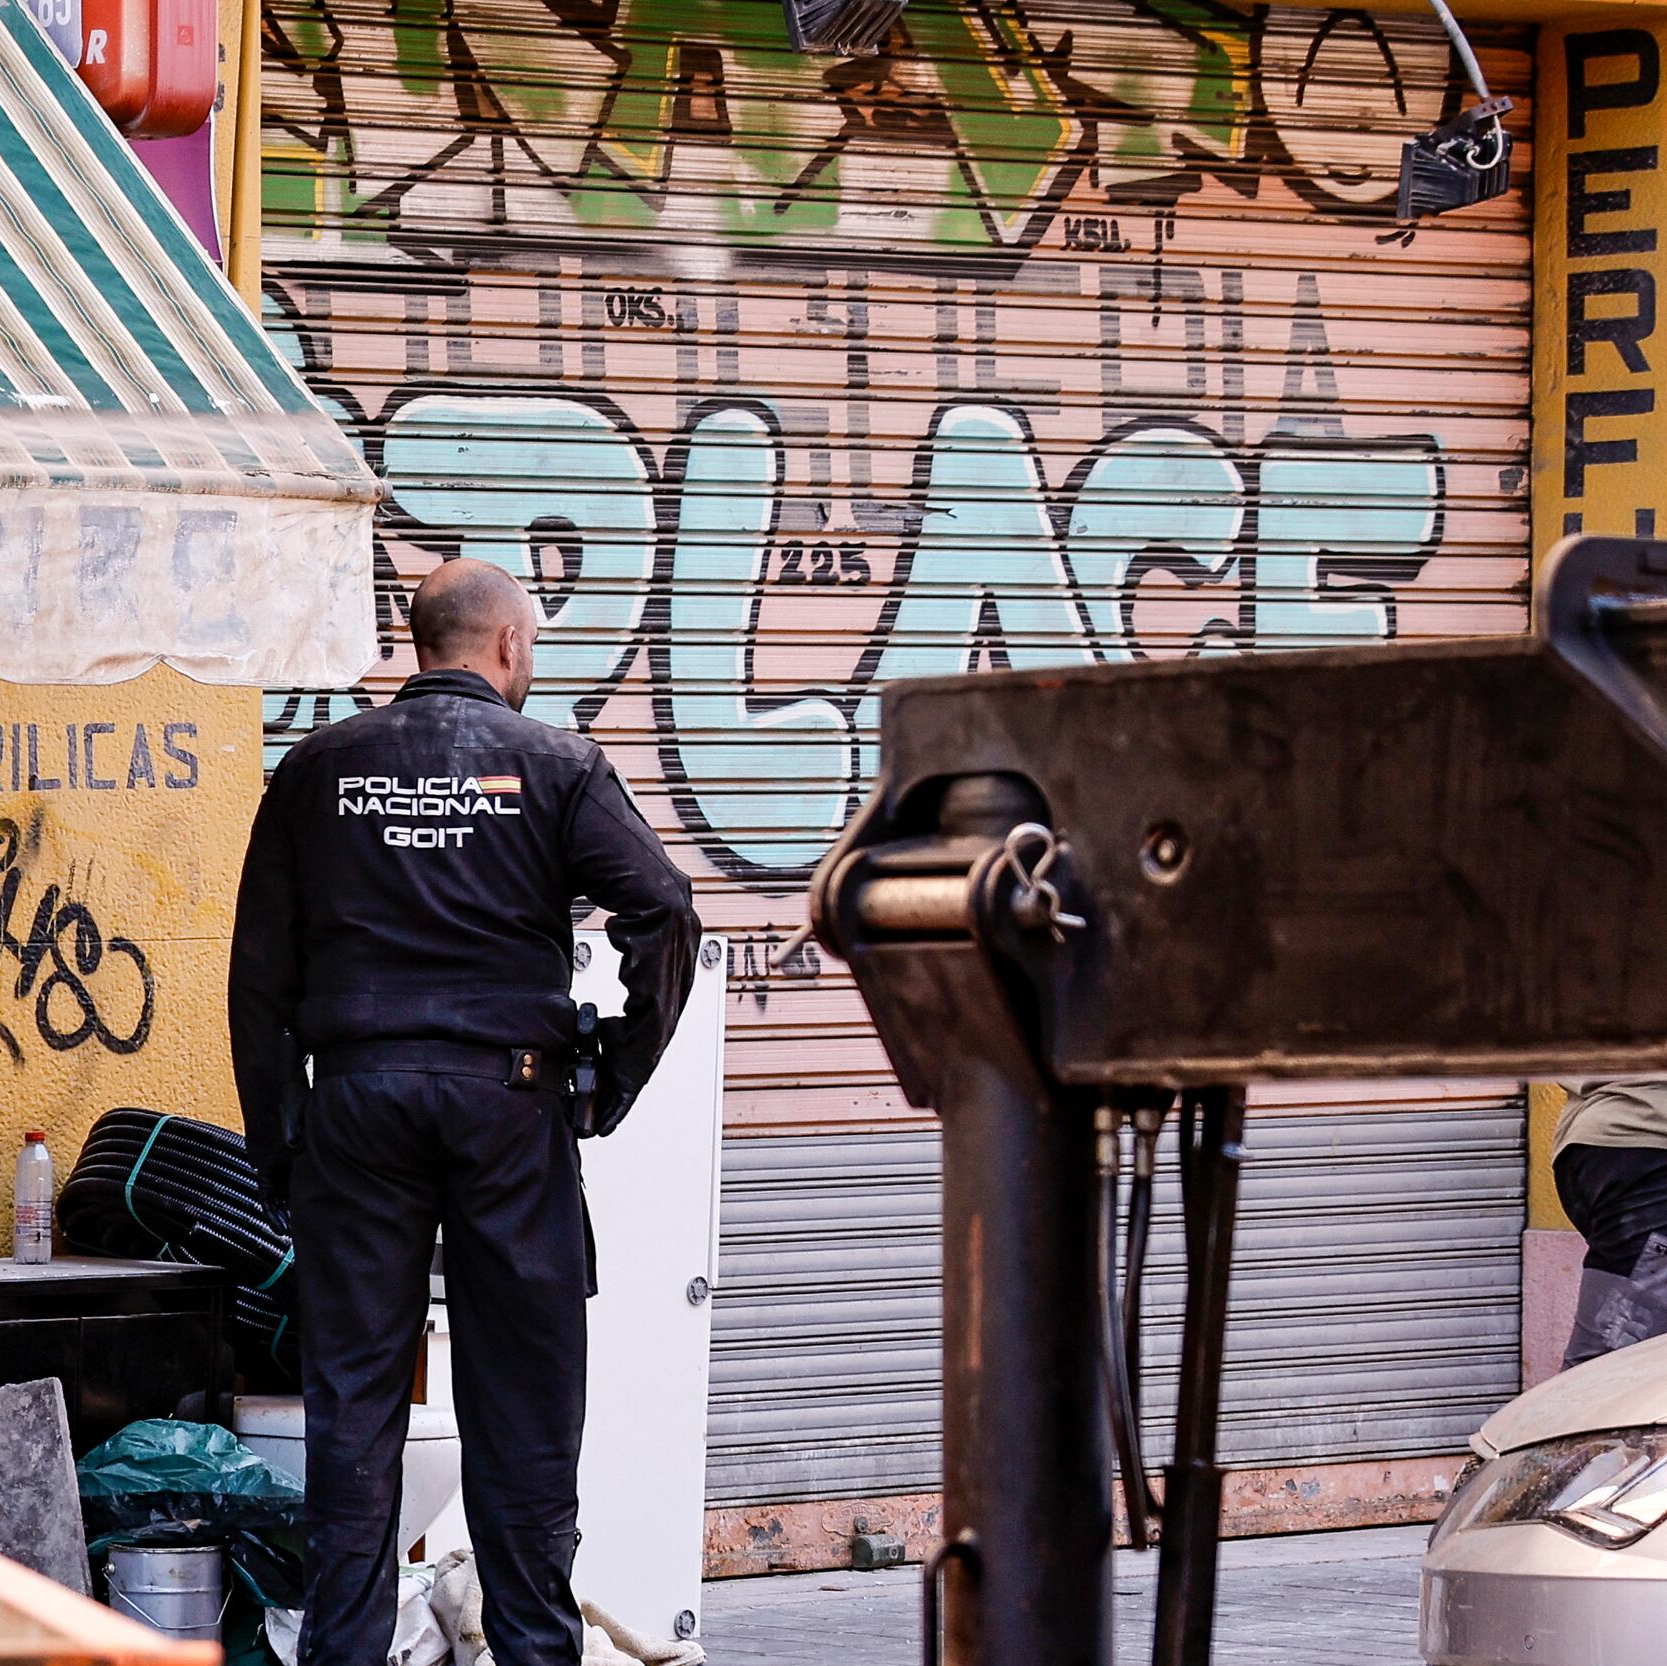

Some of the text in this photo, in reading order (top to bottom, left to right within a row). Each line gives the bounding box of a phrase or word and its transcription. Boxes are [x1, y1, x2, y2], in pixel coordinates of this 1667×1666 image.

[779, 540, 872, 586] 225
[338, 796, 521, 816] NACIONAL
[383, 825, 474, 849] GOIT
